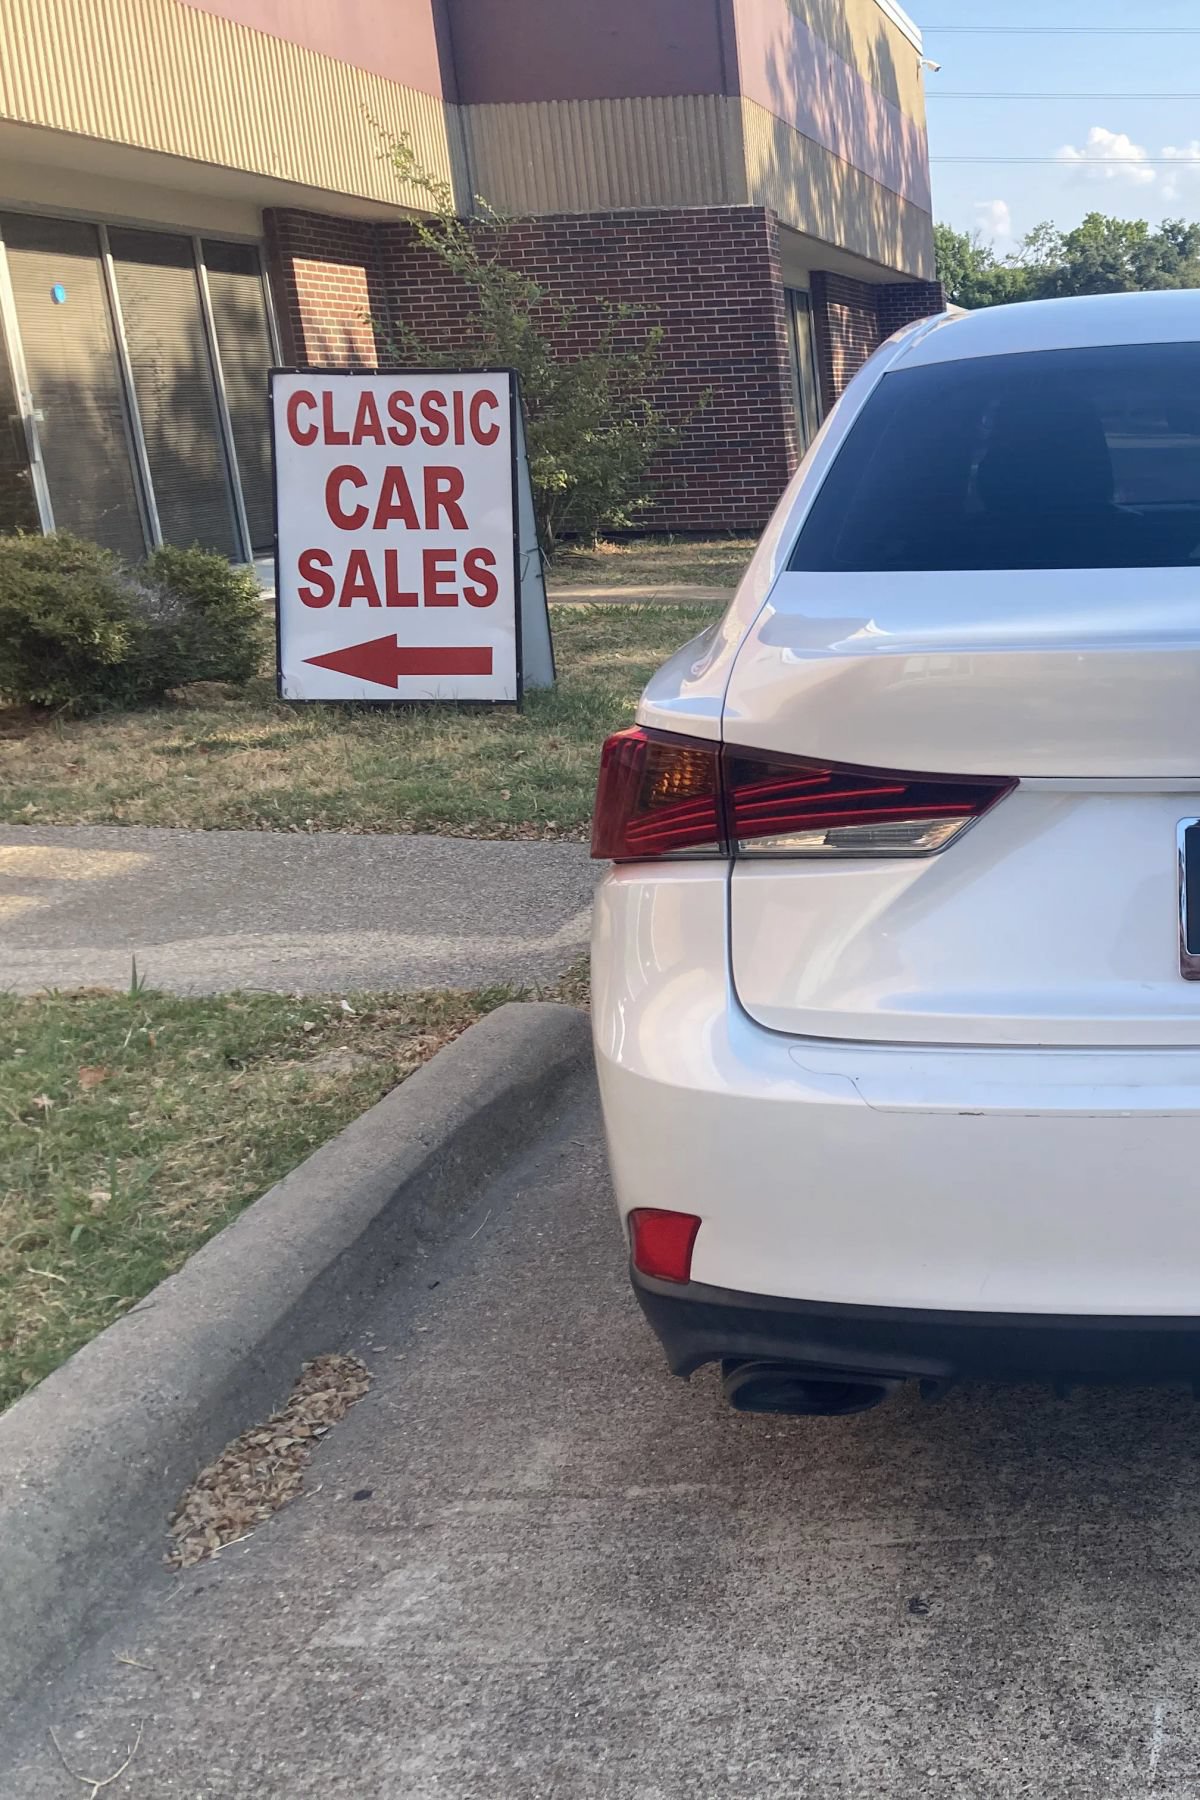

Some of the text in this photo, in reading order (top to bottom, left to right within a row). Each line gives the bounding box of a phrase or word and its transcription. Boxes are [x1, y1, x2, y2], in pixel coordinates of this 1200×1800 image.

[287, 389, 500, 446] CLASSIC
[325, 464, 469, 531] CAR
[297, 547, 499, 609] SALES
